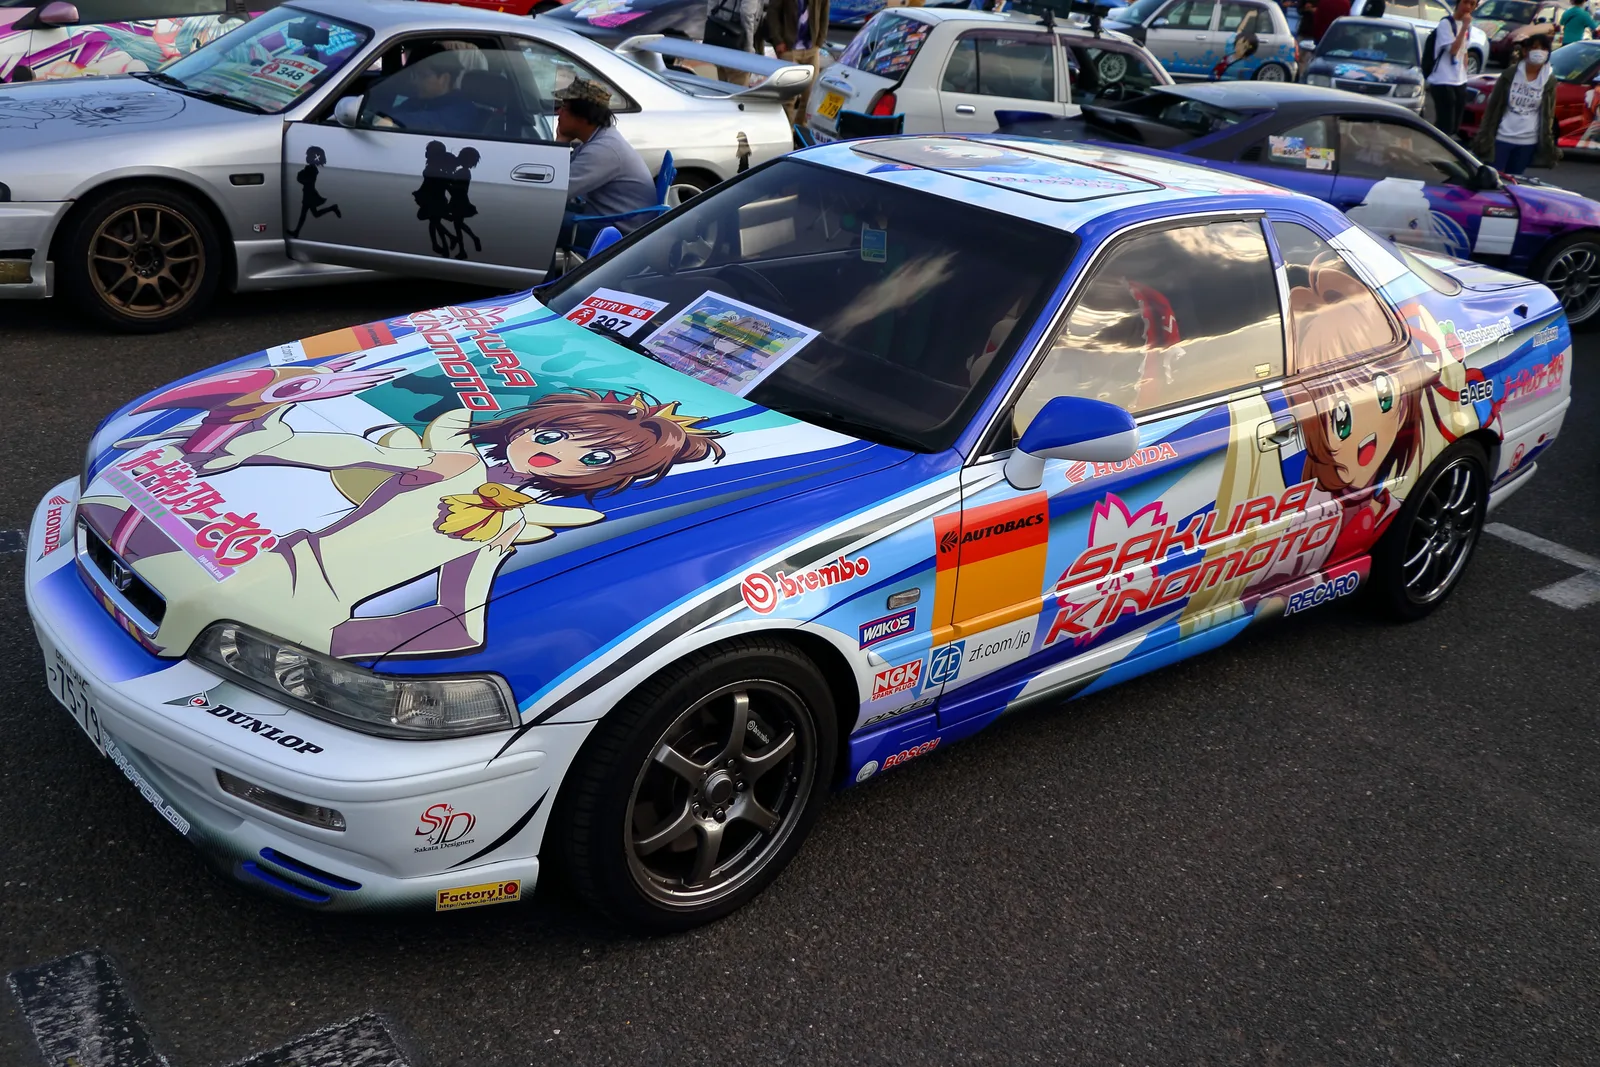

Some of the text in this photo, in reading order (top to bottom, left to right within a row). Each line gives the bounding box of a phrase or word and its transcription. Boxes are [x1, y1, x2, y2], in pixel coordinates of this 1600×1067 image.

[277, 67, 304, 81] 348
[590, 299, 626, 312] ENTRY
[589, 315, 632, 333] 397
[409, 310, 501, 411] KINOMOTO
[446, 306, 538, 387] SAKURA
[1093, 443, 1178, 478] HONDA
[44, 506, 62, 555] HONDA
[962, 513, 1045, 544] AUTOBACS
[1056, 479, 1318, 595] SAKURA
[780, 557, 869, 598] brembo
[1044, 516, 1341, 645] KINOMOTO
[1284, 572, 1360, 617] RECARO
[968, 630, 1031, 662] zf.com/jp
[872, 682, 916, 701] SPARK PLUGS
[874, 661, 920, 694] NGK
[57, 663, 101, 746] 75-79
[206, 704, 324, 755] DUNLOP
[753, 725, 770, 744] brembo
[881, 737, 942, 771] BOSCH
[102, 728, 191, 836] AKURA-OFFICIAL.COM
[414, 839, 475, 853] Sakata Designers
[439, 889, 496, 904] Factory
